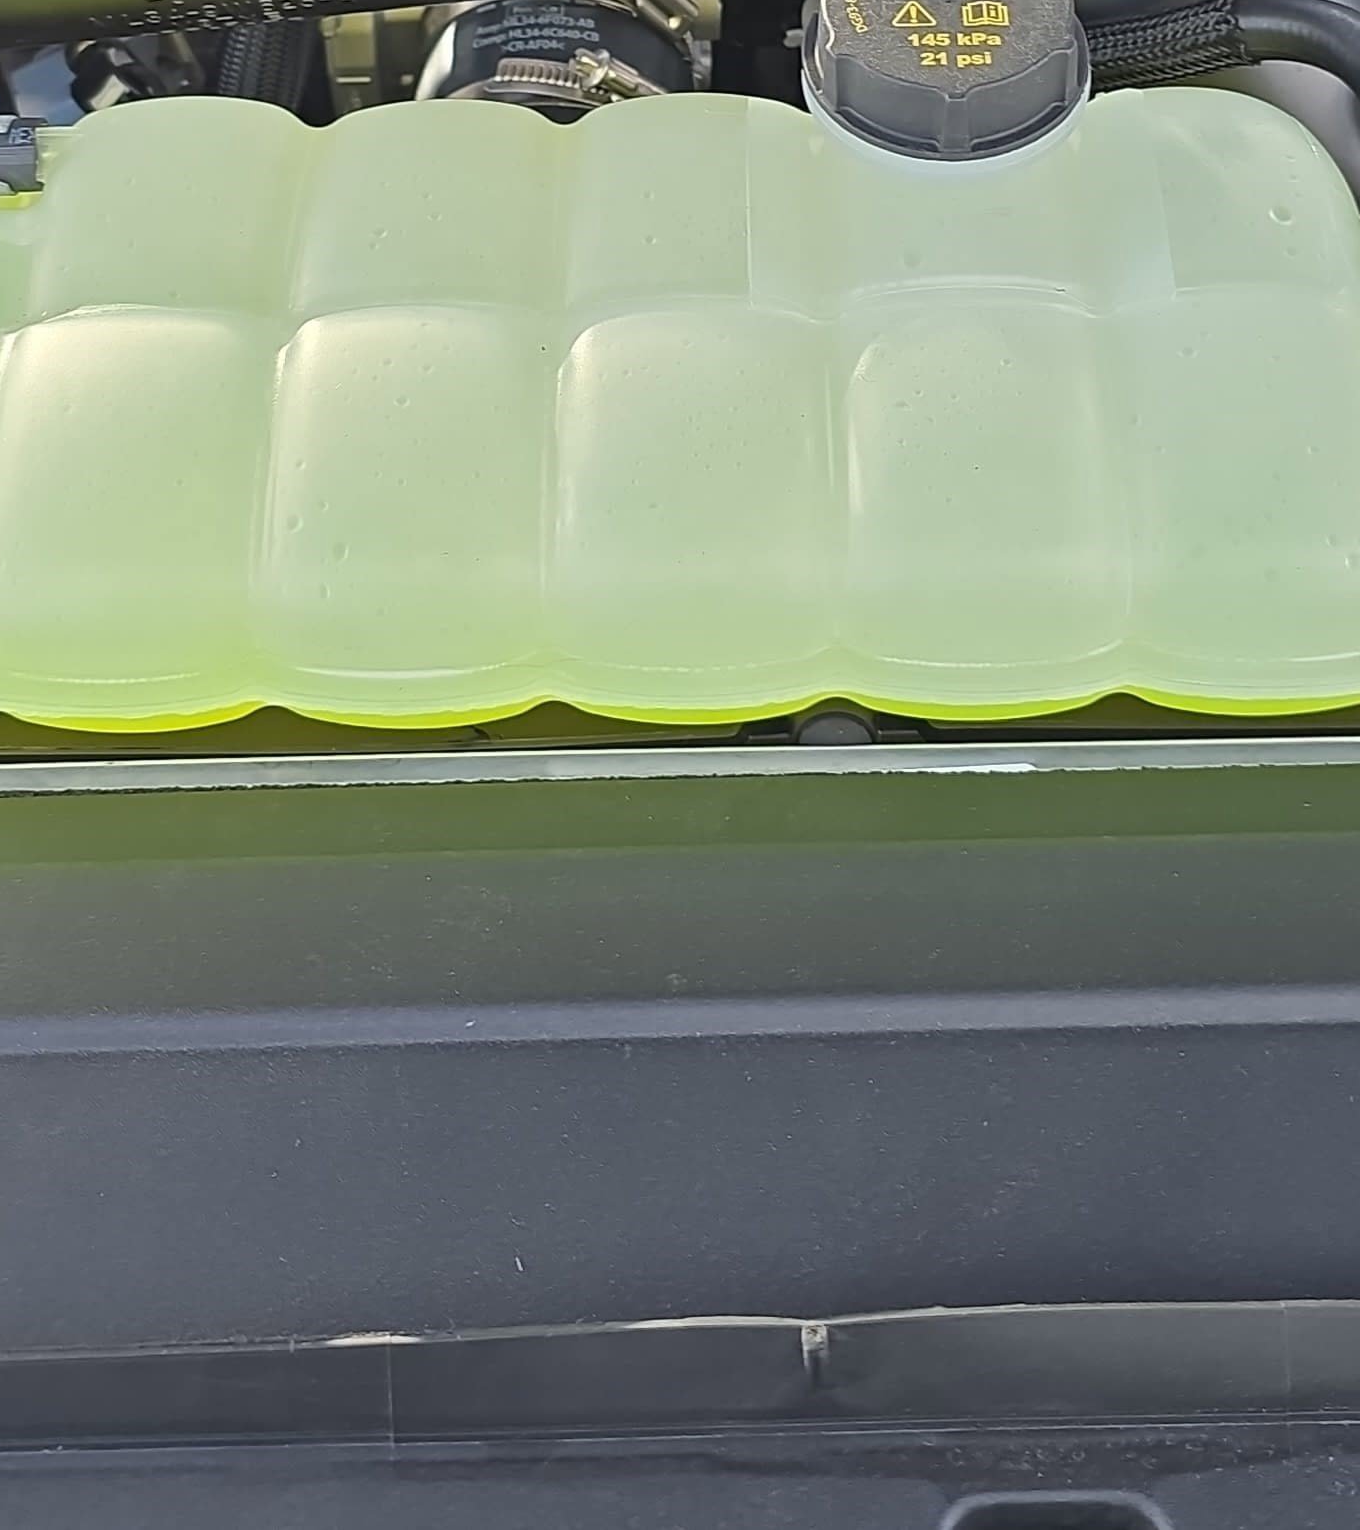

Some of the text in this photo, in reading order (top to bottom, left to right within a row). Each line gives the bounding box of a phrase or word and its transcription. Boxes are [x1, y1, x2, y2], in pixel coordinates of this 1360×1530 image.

[907, 32, 1002, 47] 145 kPa
[919, 51, 992, 68] 21 psi
